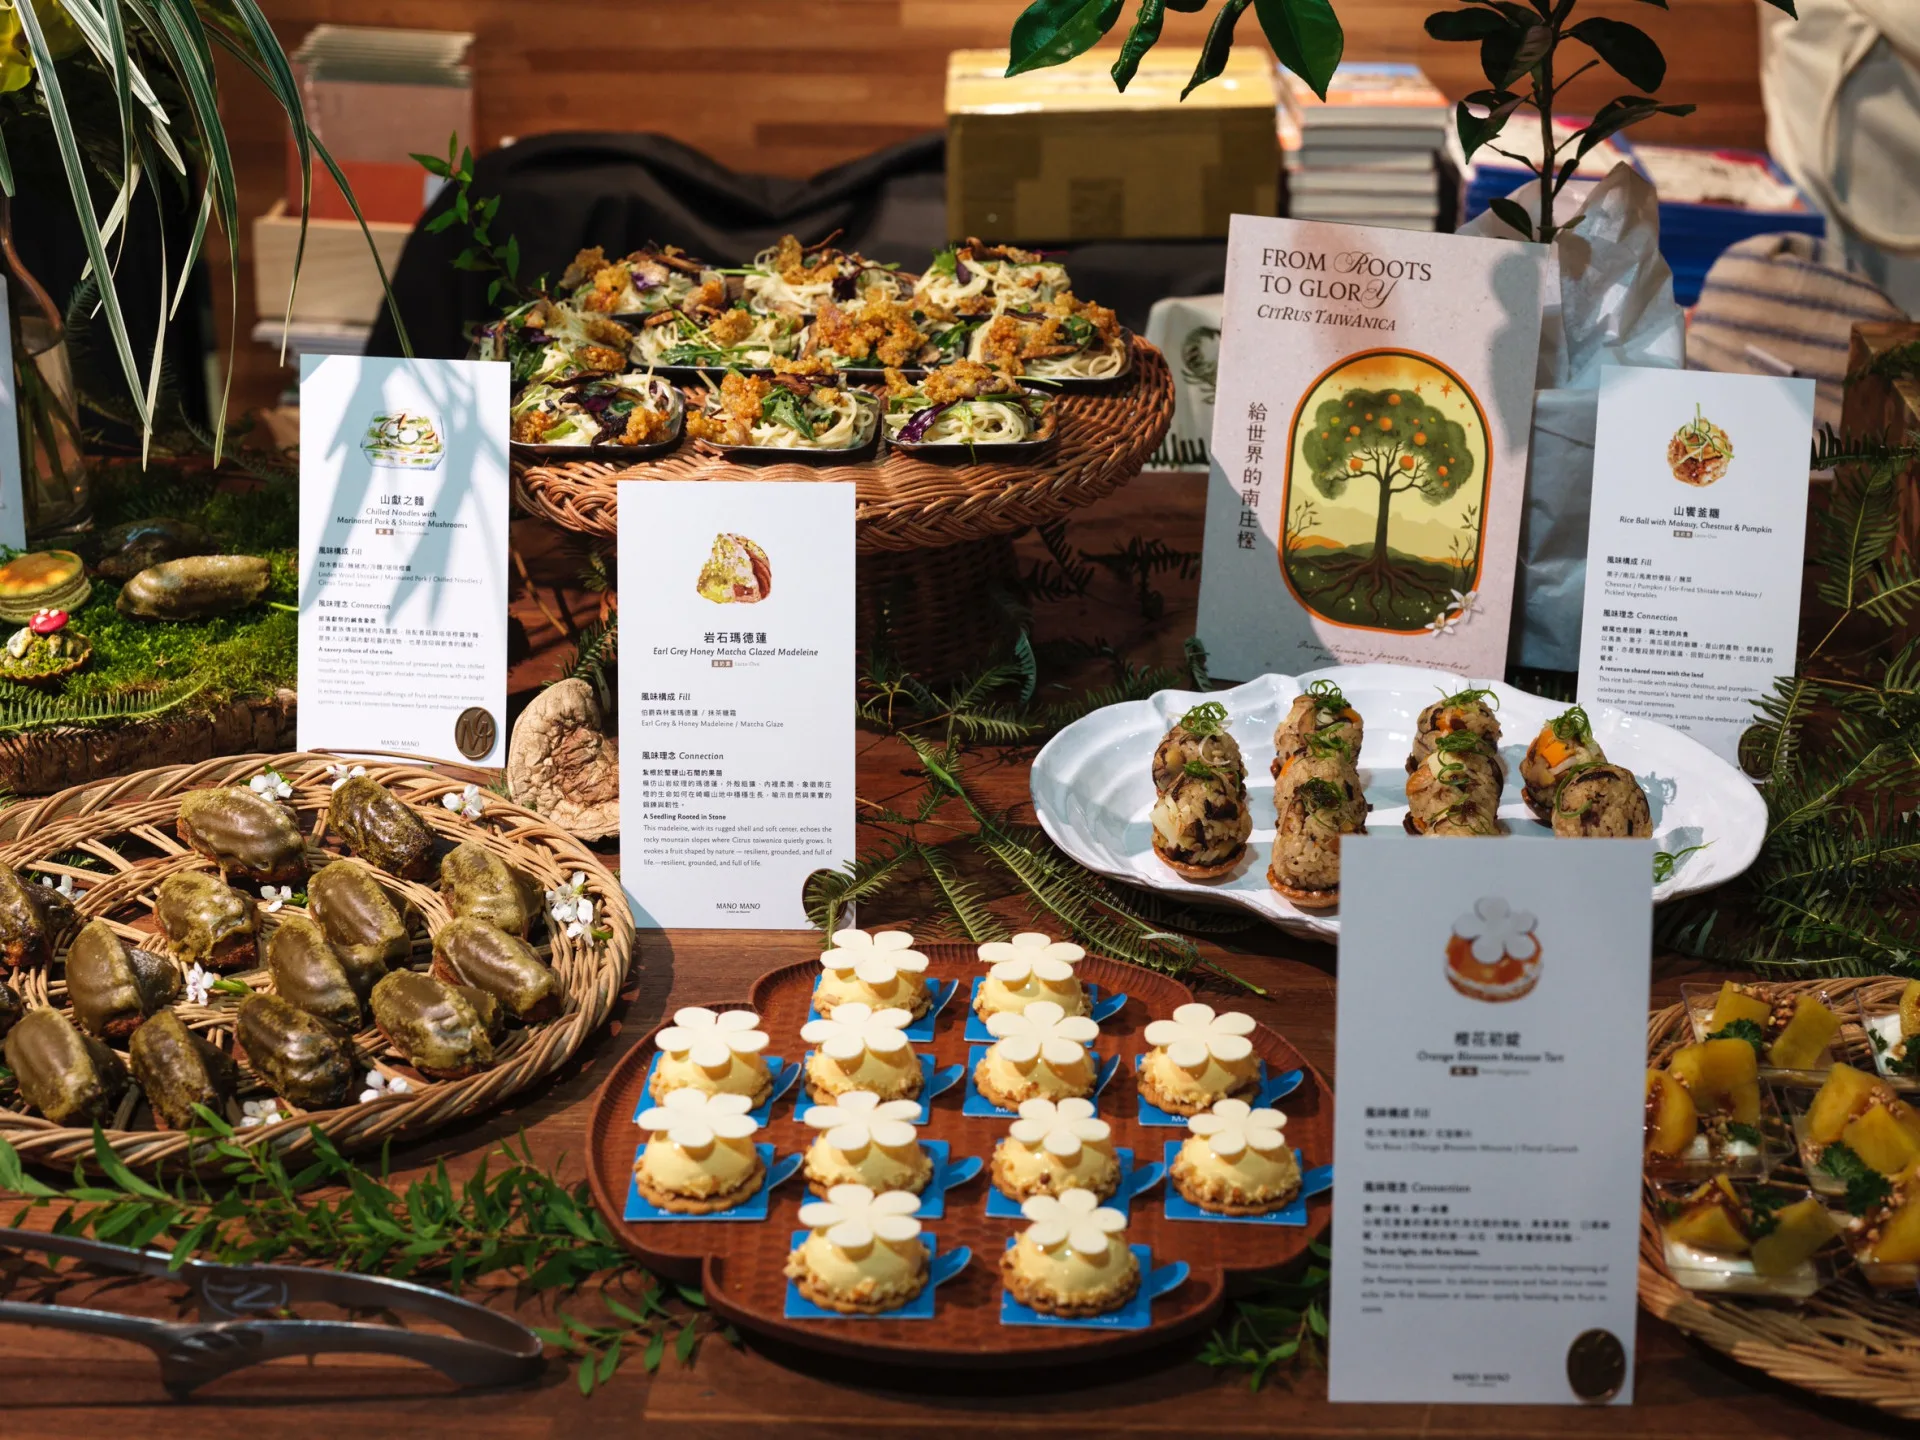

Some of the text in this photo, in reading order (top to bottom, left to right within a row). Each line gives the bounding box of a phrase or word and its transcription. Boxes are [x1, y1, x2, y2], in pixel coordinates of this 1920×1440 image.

[1262, 248, 1432, 281] FROM ROOTS
[1260, 275, 1398, 309] TO GLORY
[1237, 402, 1267, 550] 給世界的南庄橙
[380, 494, 424, 505] 山獻之麵
[1619, 515, 1634, 523] Rice
[1635, 516, 1649, 524] Ball
[1700, 521, 1732, 530] Chestnut
[1741, 524, 1772, 534] Pumpkin
[318, 546, 348, 555] 風味構成
[1606, 555, 1637, 565] 風味構成
[1604, 580, 1631, 588] Chestnut
[1604, 588, 1657, 599] Pickled Vegetables
[318, 599, 347, 607] 風味理念
[1603, 609, 1677, 621] 風味理念 Connection
[704, 632, 766, 643] 岩石瑪德蓮
[670, 647, 687, 656] Grey
[690, 647, 714, 656] Honey
[748, 647, 775, 655] Glazed
[641, 692, 690, 700] 風味構成 Fill
[678, 720, 698, 728] Honey
[642, 751, 675, 759] 風味理念
